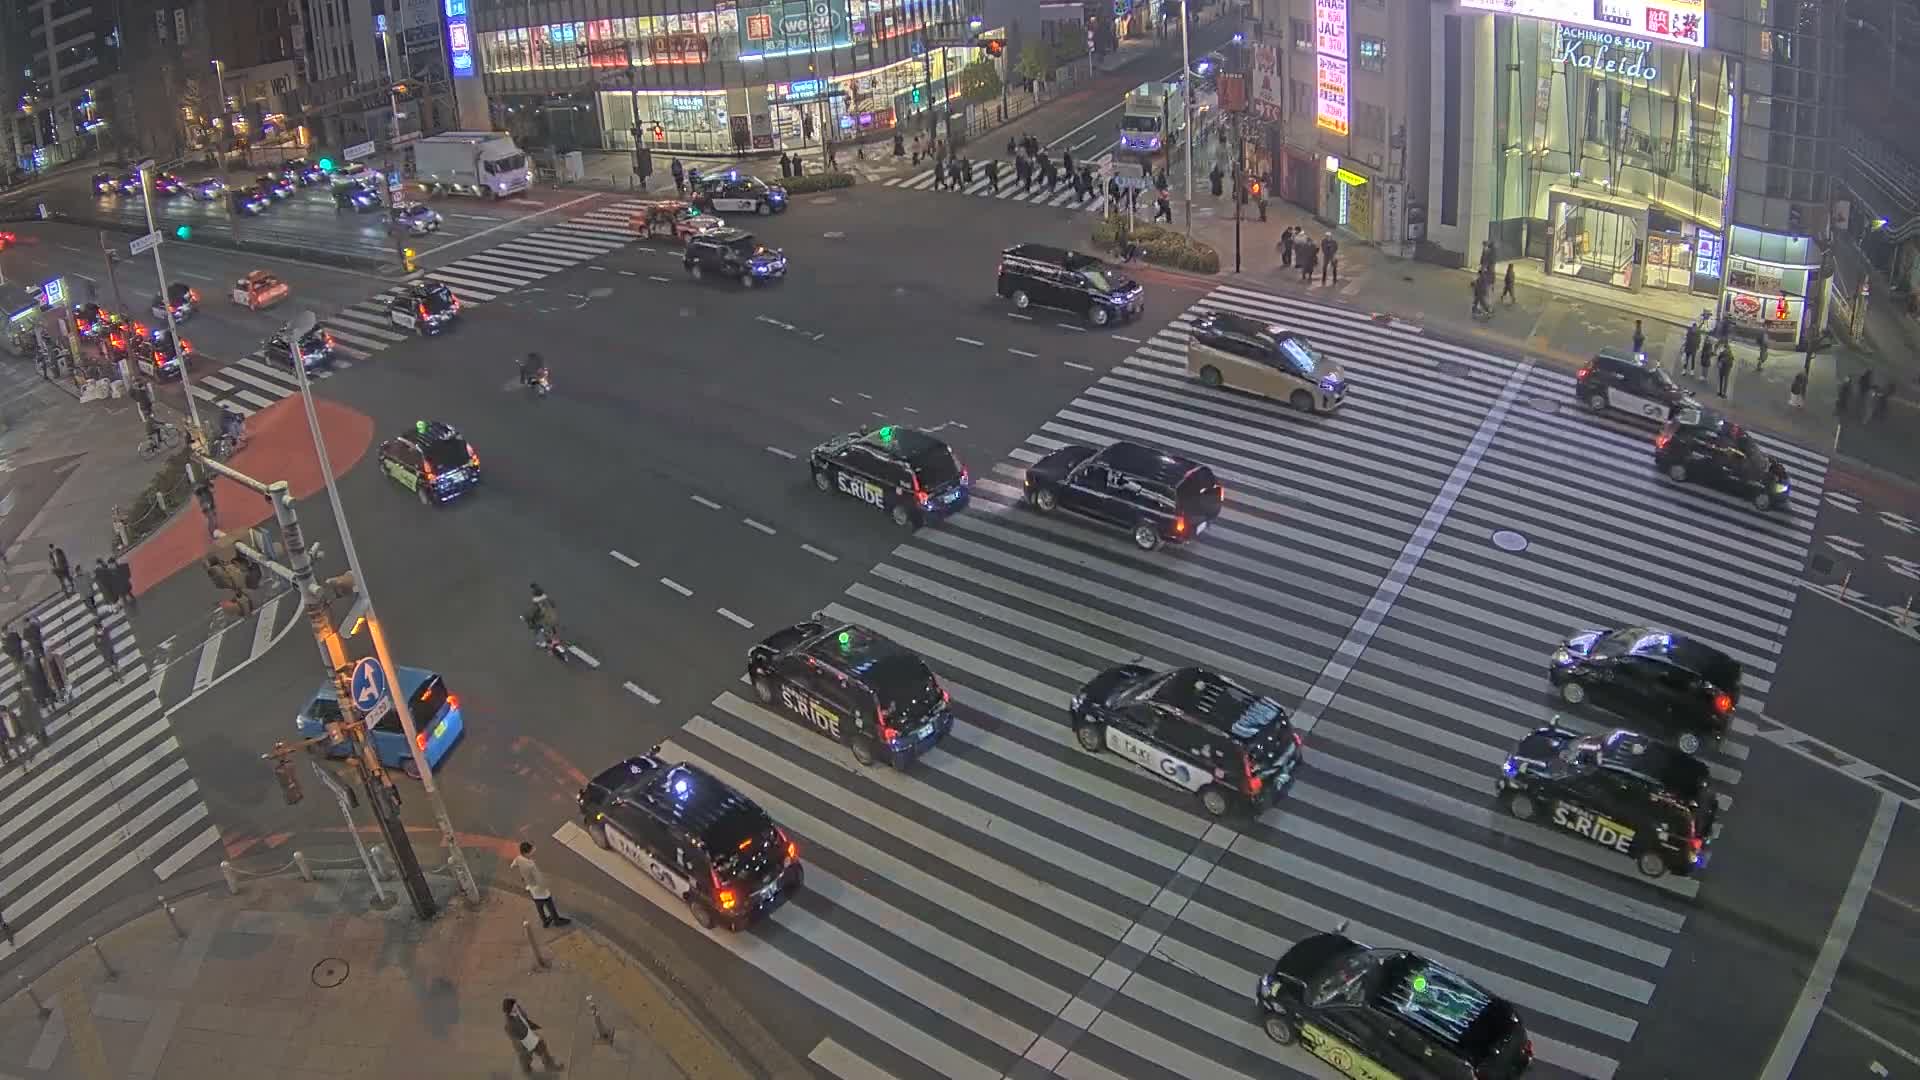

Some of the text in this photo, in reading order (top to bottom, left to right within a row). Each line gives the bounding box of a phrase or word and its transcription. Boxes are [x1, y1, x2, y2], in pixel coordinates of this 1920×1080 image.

[1319, 21, 1338, 37] JAL
[1558, 26, 1653, 52] PACHINKO & SLOT
[1564, 40, 1656, 80] Kaleido
[838, 476, 885, 509] S.RIDE
[782, 690, 840, 738] S.RIDE
[1553, 807, 1634, 853] S.RIDE
